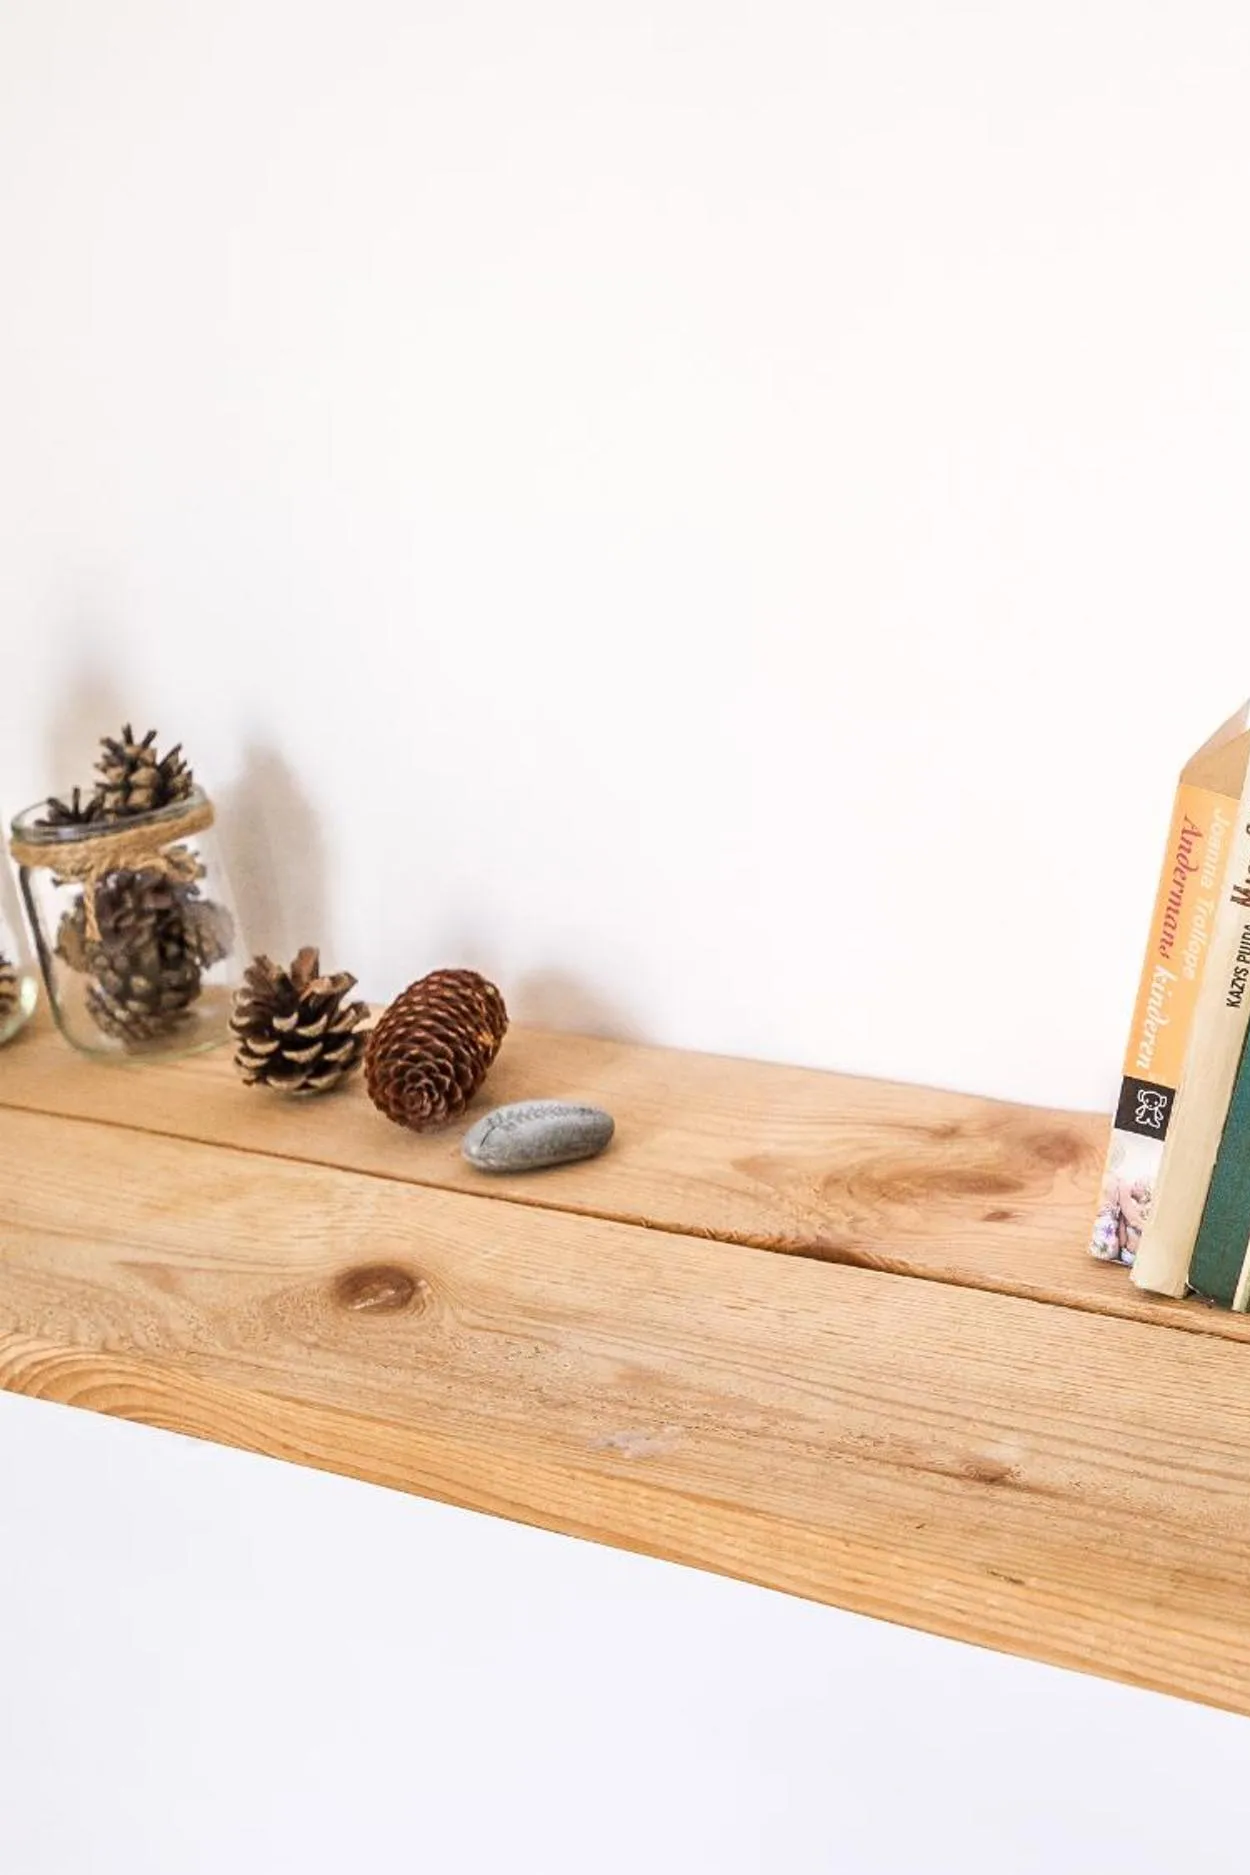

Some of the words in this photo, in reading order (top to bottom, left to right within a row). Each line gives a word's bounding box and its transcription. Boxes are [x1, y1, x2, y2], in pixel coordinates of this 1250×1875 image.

[1159, 815, 1203, 961] Andermans
[1136, 964, 1178, 1070] kinderen
[1226, 968, 1247, 1008] KAZYS
